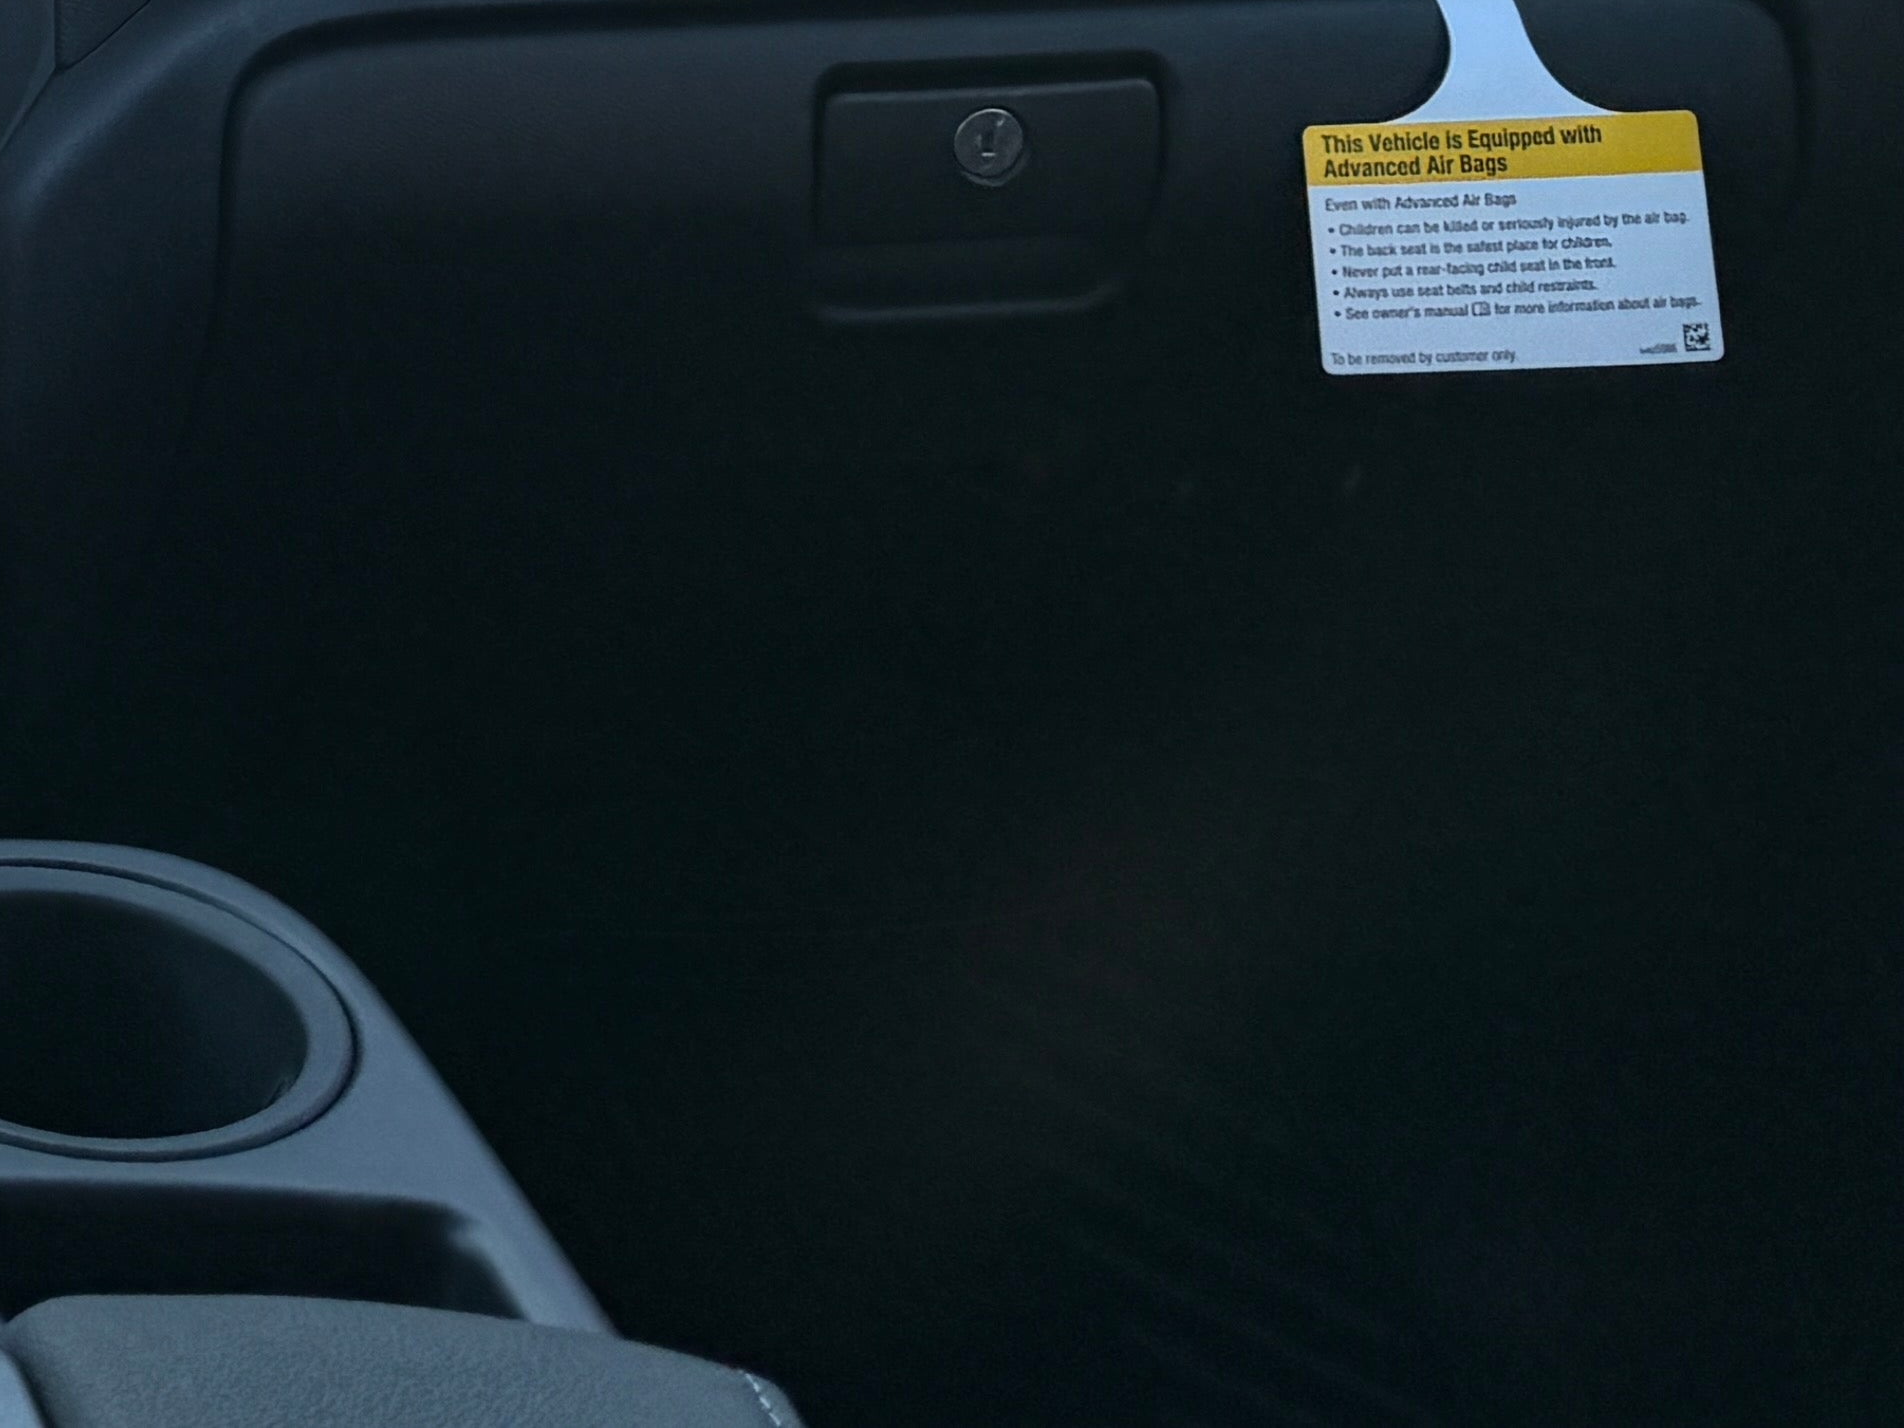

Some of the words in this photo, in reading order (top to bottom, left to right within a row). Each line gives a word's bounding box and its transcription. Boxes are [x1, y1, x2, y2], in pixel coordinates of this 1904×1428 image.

[1322, 134, 1363, 154] This
[1368, 131, 1439, 153] Vehicle
[1446, 129, 1462, 149] is
[1468, 126, 1555, 152] Equipped
[1560, 124, 1602, 144] with
[1324, 156, 1421, 178] Advanced
[1427, 154, 1454, 175] Air
[1459, 153, 1508, 176] Bags
[1326, 197, 1357, 211] Even
[1362, 197, 1391, 210] with
[1395, 195, 1459, 209] Advanced
[1463, 193, 1481, 206] Air
[1485, 192, 1517, 208] Bags
[1339, 221, 1393, 236] Children
[1397, 223, 1421, 235] can
[1424, 220, 1439, 234] be
[1444, 220, 1478, 233] killed
[1482, 221, 1495, 232] or
[1499, 217, 1553, 232] seriously
[1558, 214, 1601, 229] injured
[1603, 213, 1618, 228] by
[1622, 213, 1642, 225] the
[1645, 211, 1661, 224] air
[1341, 244, 1364, 257] The
[1367, 243, 1397, 256] back
[1401, 243, 1426, 255] seat
[1430, 243, 1441, 254] is
[1444, 241, 1462, 253] the
[1467, 240, 1503, 253] safest
[1507, 239, 1538, 253] place
[1542, 238, 1558, 250] for
[1342, 266, 1378, 278] Never
[1382, 265, 1402, 279] put
[1416, 262, 1484, 277] rear-facing
[1487, 260, 1516, 273] child
[1520, 259, 1546, 272] seat
[1549, 257, 1560, 271] in
[1563, 258, 1582, 270] the
[1344, 286, 1389, 301] Always
[1392, 287, 1413, 298] use
[1417, 285, 1444, 297] seat
[1446, 283, 1477, 296] belts
[1479, 282, 1503, 295] and
[1506, 281, 1535, 293] child
[1345, 307, 1369, 320] See
[1372, 307, 1421, 319] owner's
[1424, 304, 1469, 317] manual
[1494, 302, 1511, 315] for
[1514, 303, 1545, 314] more
[1548, 299, 1615, 313] information
[1618, 297, 1650, 310] about
[1653, 296, 1667, 308] air
[1331, 352, 1345, 365] To
[1347, 352, 1362, 366] be
[1365, 351, 1416, 365] removed
[1419, 351, 1432, 366] by
[1435, 349, 1489, 363] customer
